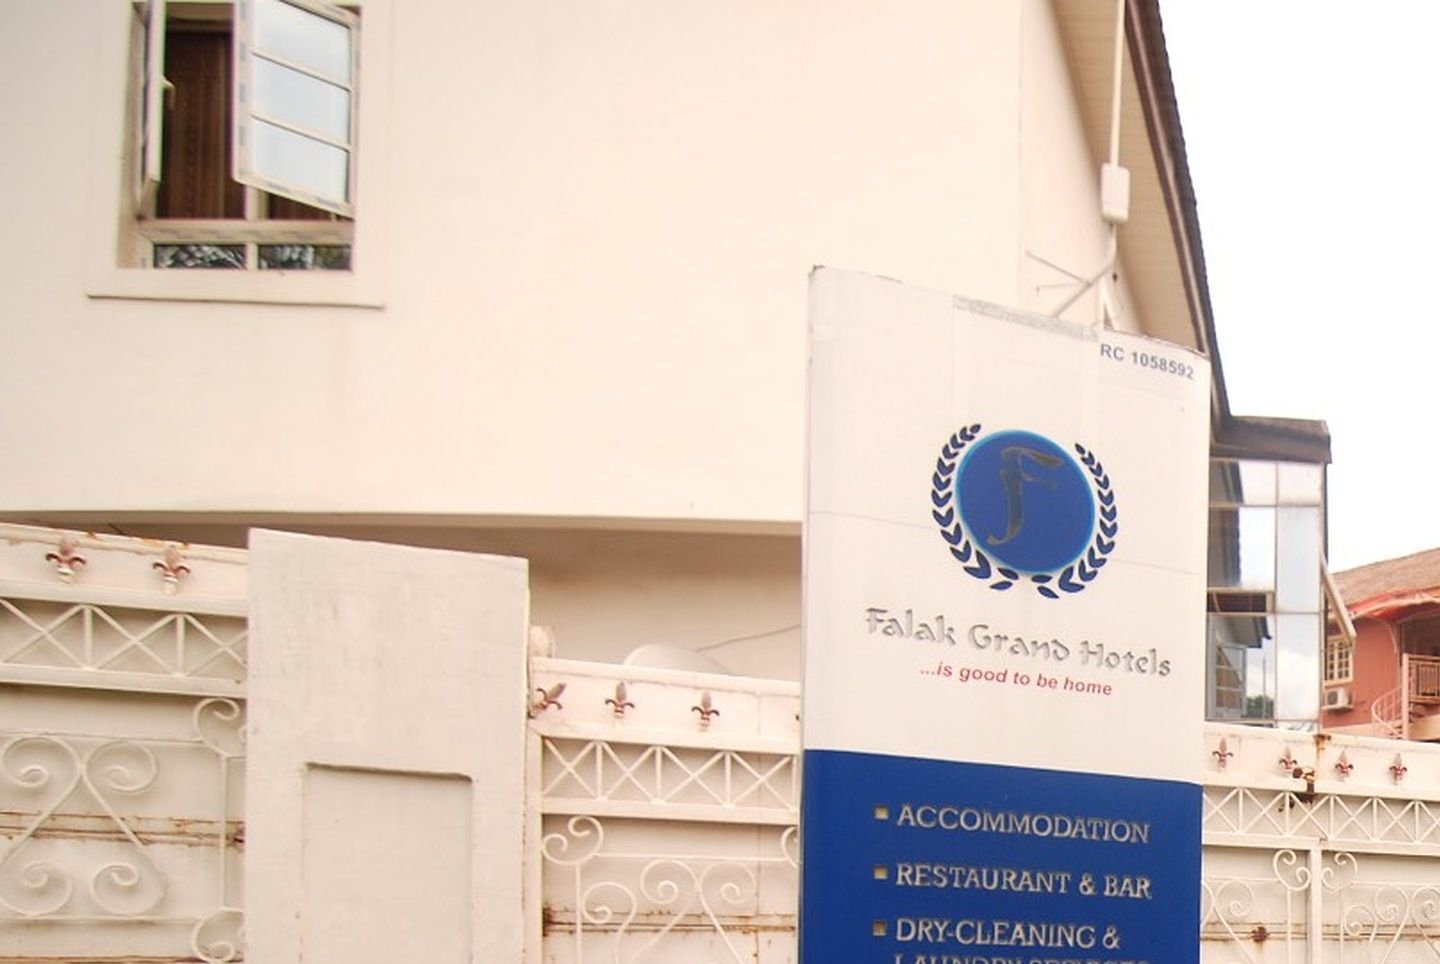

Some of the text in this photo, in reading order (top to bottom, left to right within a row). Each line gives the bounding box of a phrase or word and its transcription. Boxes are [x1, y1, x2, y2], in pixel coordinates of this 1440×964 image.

[1100, 344, 1194, 380] RC 1058592
[866, 608, 1171, 678] Falak Grand Hotels
[920, 661, 1113, 697] ...is good to be home
[897, 804, 1150, 844] ACCOMMODATION
[895, 864, 1152, 900] RESTAURANT & BAR
[895, 918, 1120, 949] DRY-CLEANING &
